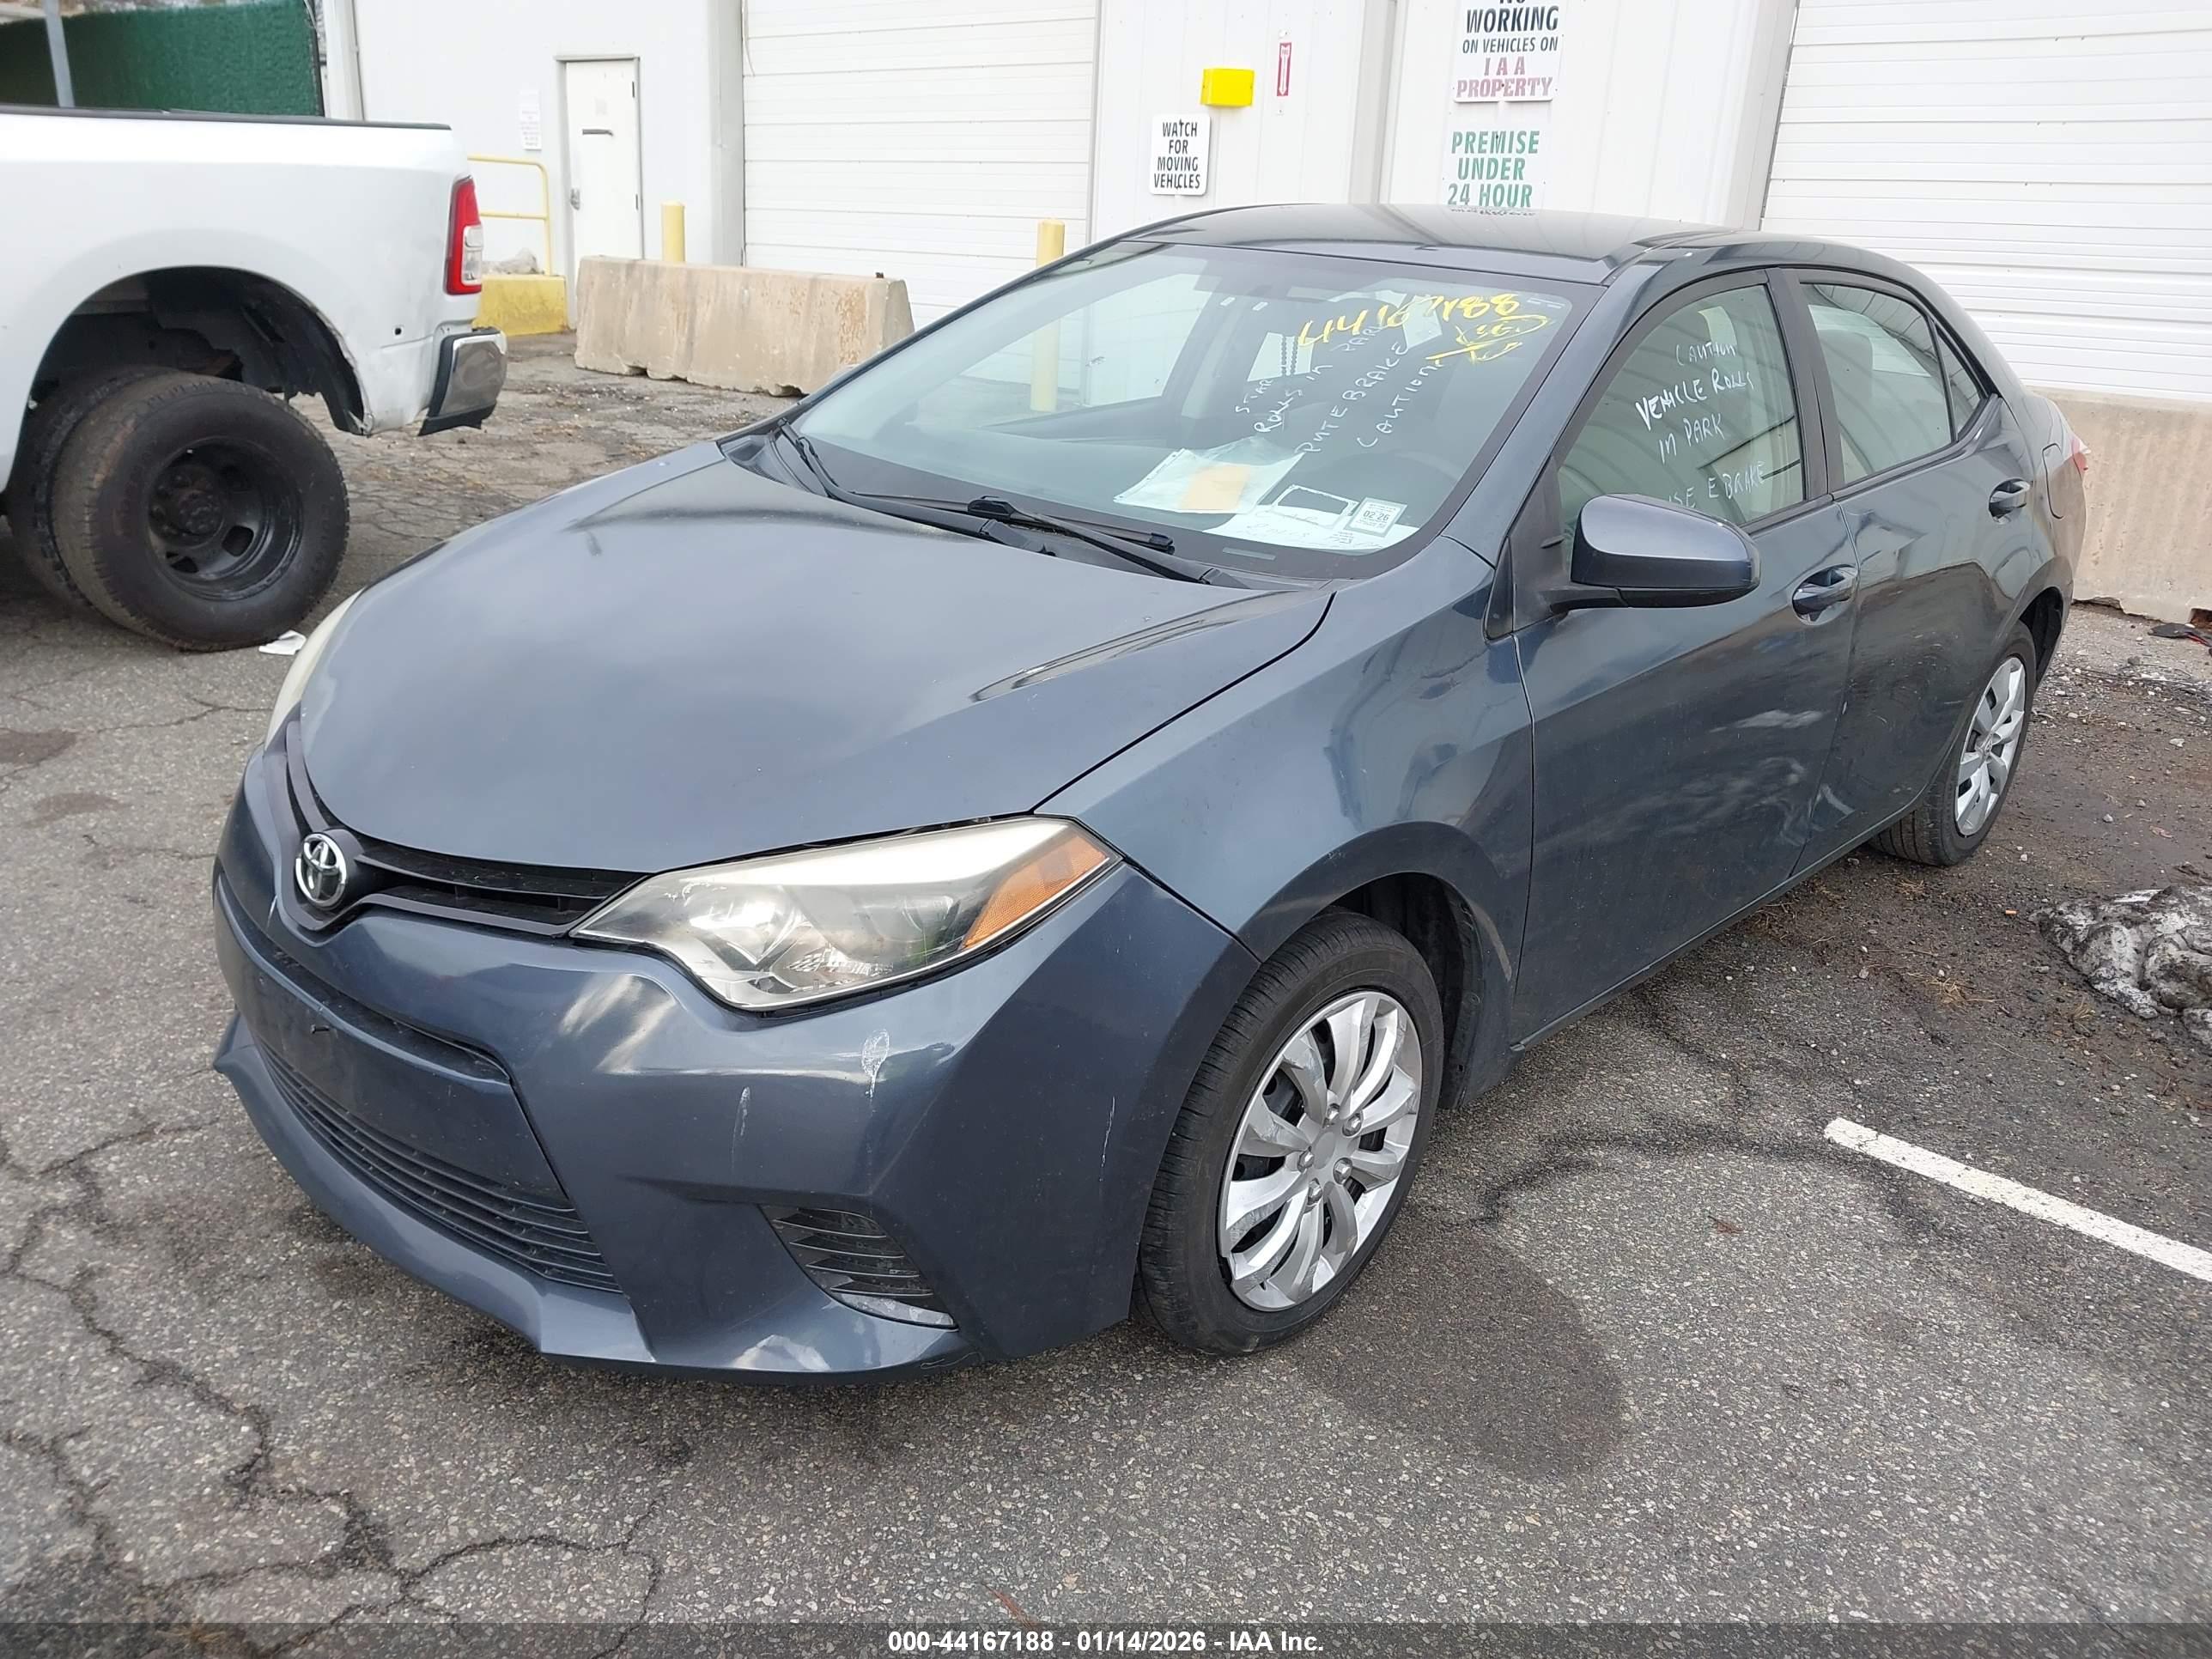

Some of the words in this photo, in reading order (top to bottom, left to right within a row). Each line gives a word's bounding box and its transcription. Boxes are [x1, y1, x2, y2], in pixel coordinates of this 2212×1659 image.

[1466, 5, 1559, 33] WORKING
[1462, 39, 1479, 53] ON
[1483, 37, 1535, 53] VEHICLES
[1540, 36, 1559, 52] ON
[1456, 76, 1553, 98] PROPERTY
[1162, 121, 1198, 137] WATCH
[1169, 139, 1188, 155] FOR
[1451, 130, 1540, 154] PREMISE
[1157, 156, 1198, 172] MOVING
[1457, 157, 1526, 180] UNDER
[1153, 173, 1200, 189] VEHICLES
[1448, 183, 1470, 206] 24
[1479, 183, 1533, 208] HOUR
[1683, 412, 1726, 447] PARK
[1707, 477, 1719, 499] E
